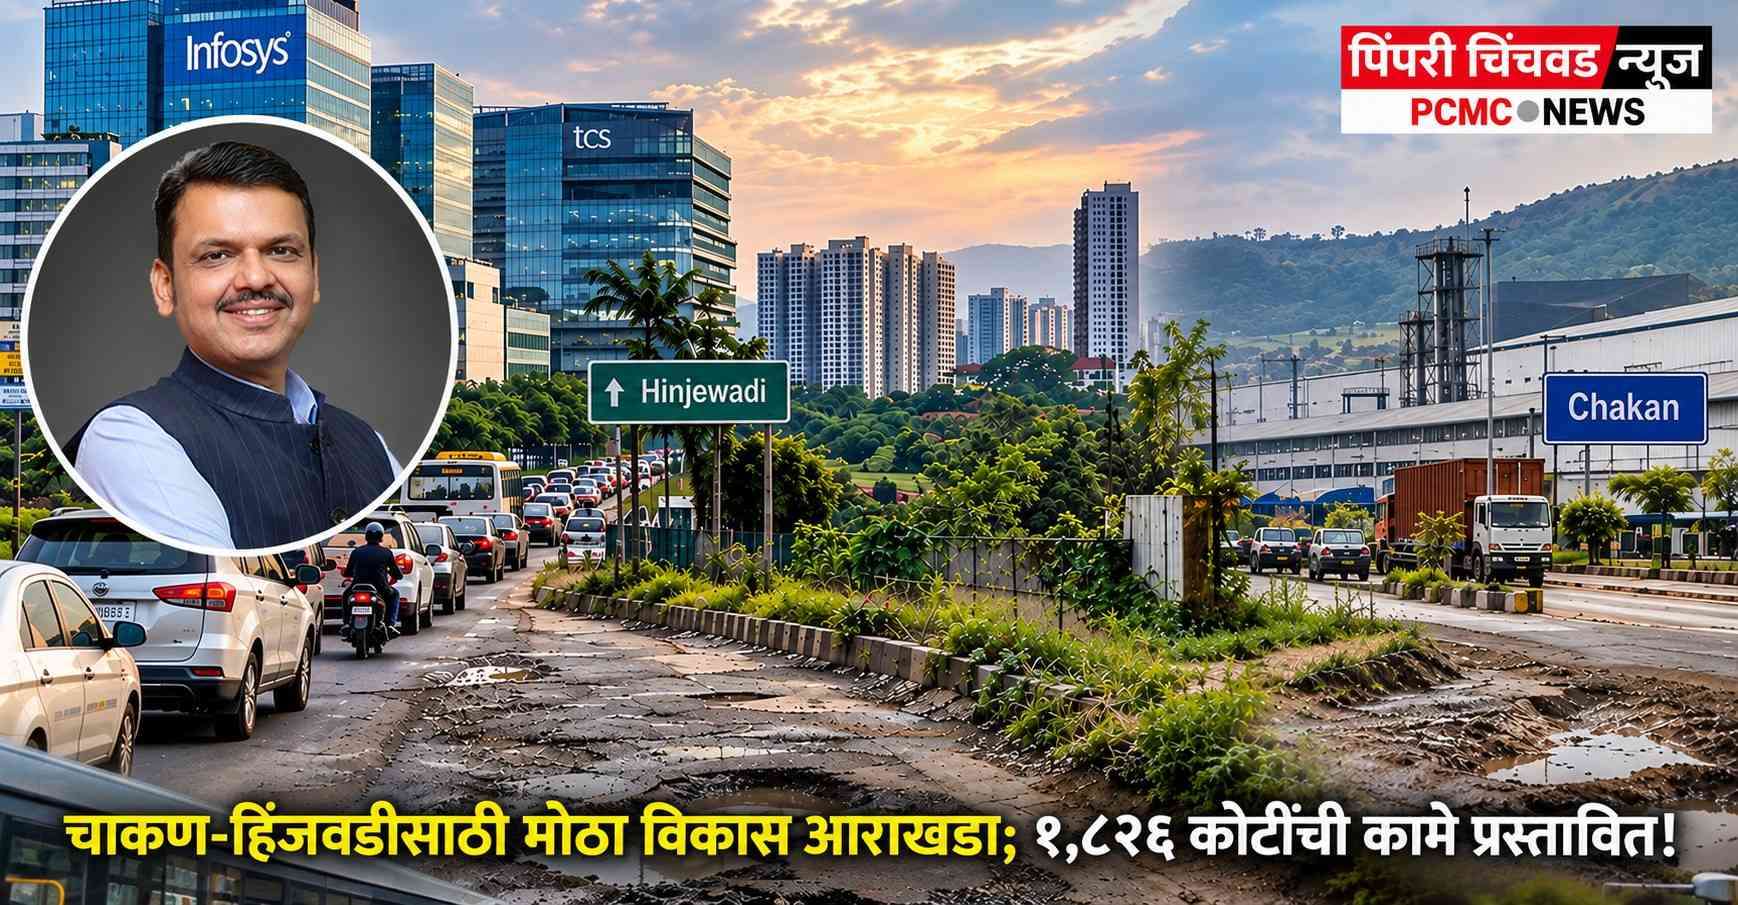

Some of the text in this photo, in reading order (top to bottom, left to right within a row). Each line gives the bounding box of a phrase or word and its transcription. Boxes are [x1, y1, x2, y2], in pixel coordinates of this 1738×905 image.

[187, 31, 290, 74] Infosys
[573, 126, 611, 149] tcs
[641, 378, 766, 409] Hinjewadi
[1568, 392, 1680, 421] Chakan
